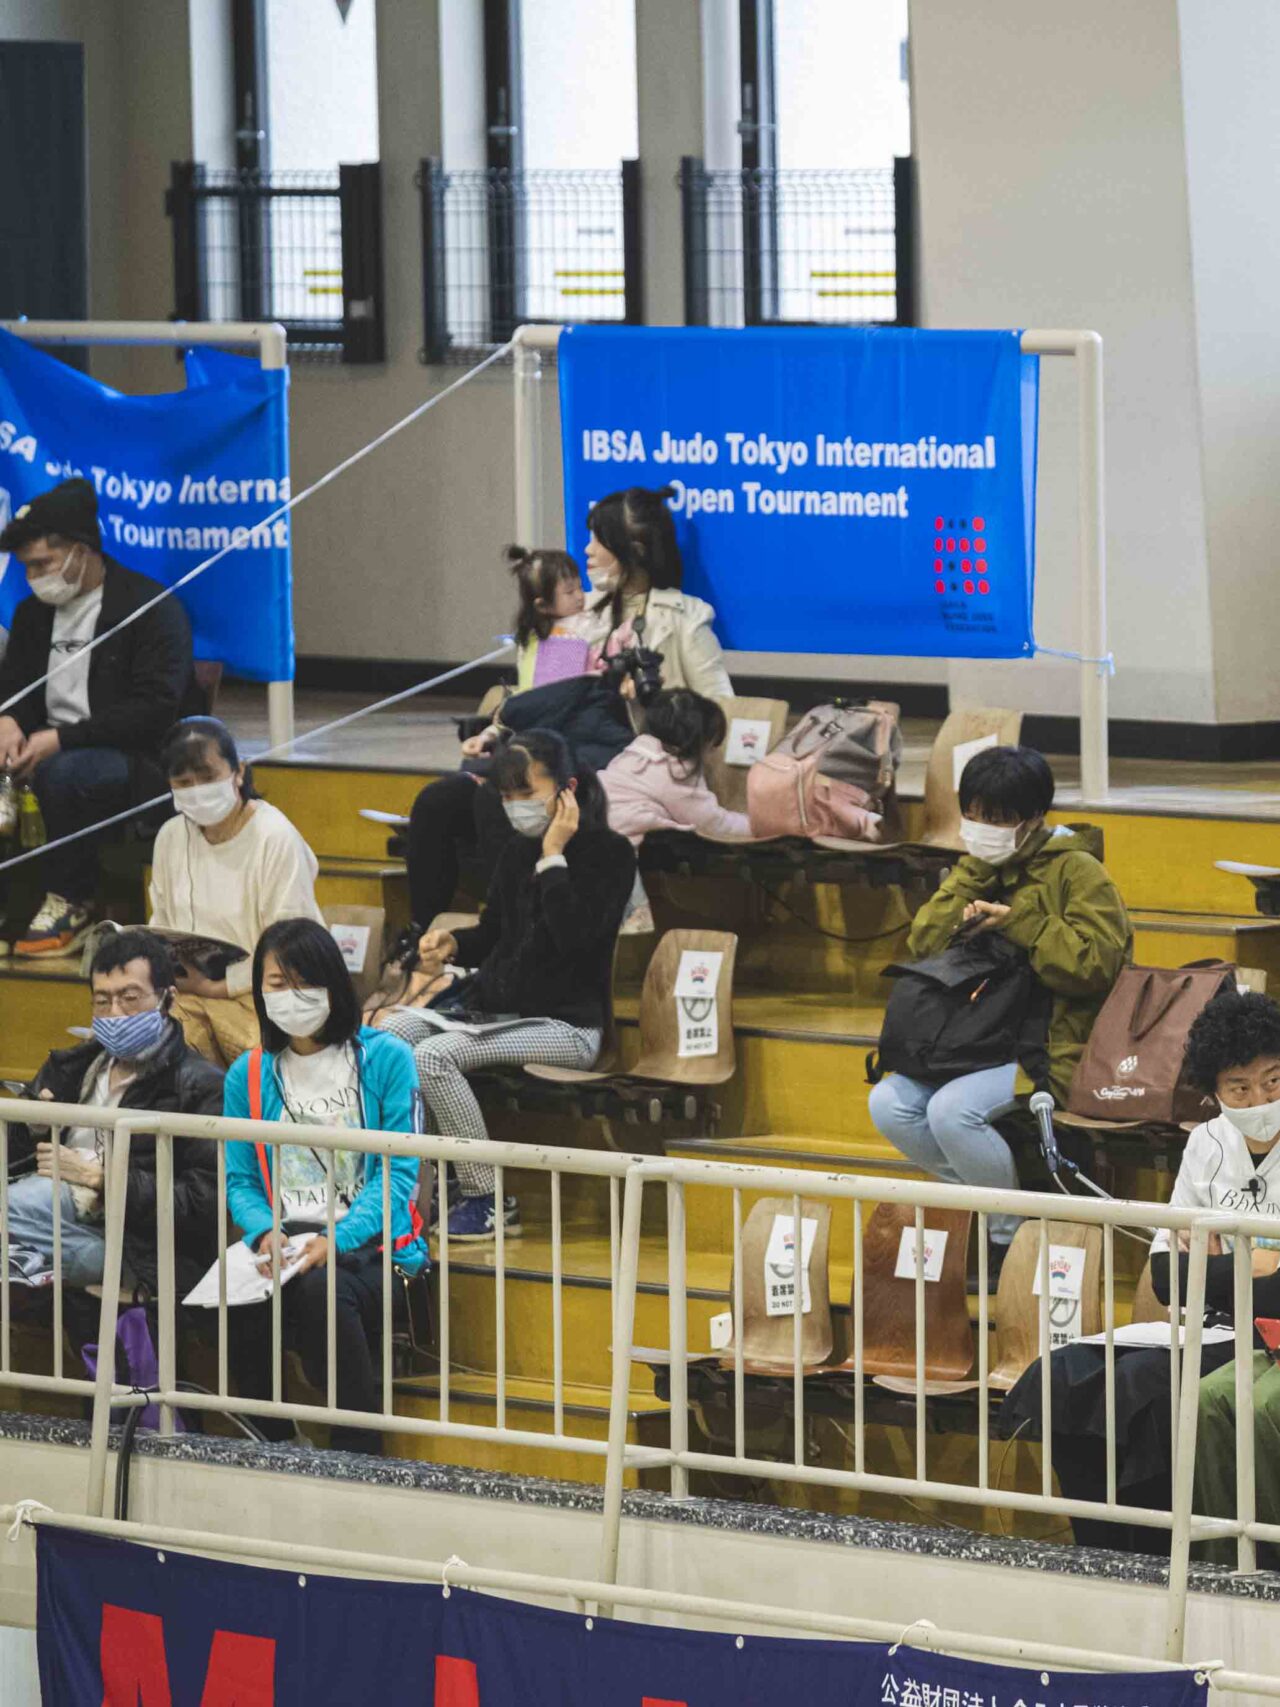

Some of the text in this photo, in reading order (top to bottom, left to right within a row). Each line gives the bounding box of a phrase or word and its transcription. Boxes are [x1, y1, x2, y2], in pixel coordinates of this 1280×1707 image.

[583, 430, 996, 474] IBSA Judo Tokyo International
[91, 467, 172, 509] Tokyo
[667, 480, 909, 518] Open Tournament
[109, 514, 289, 550] Tournament
